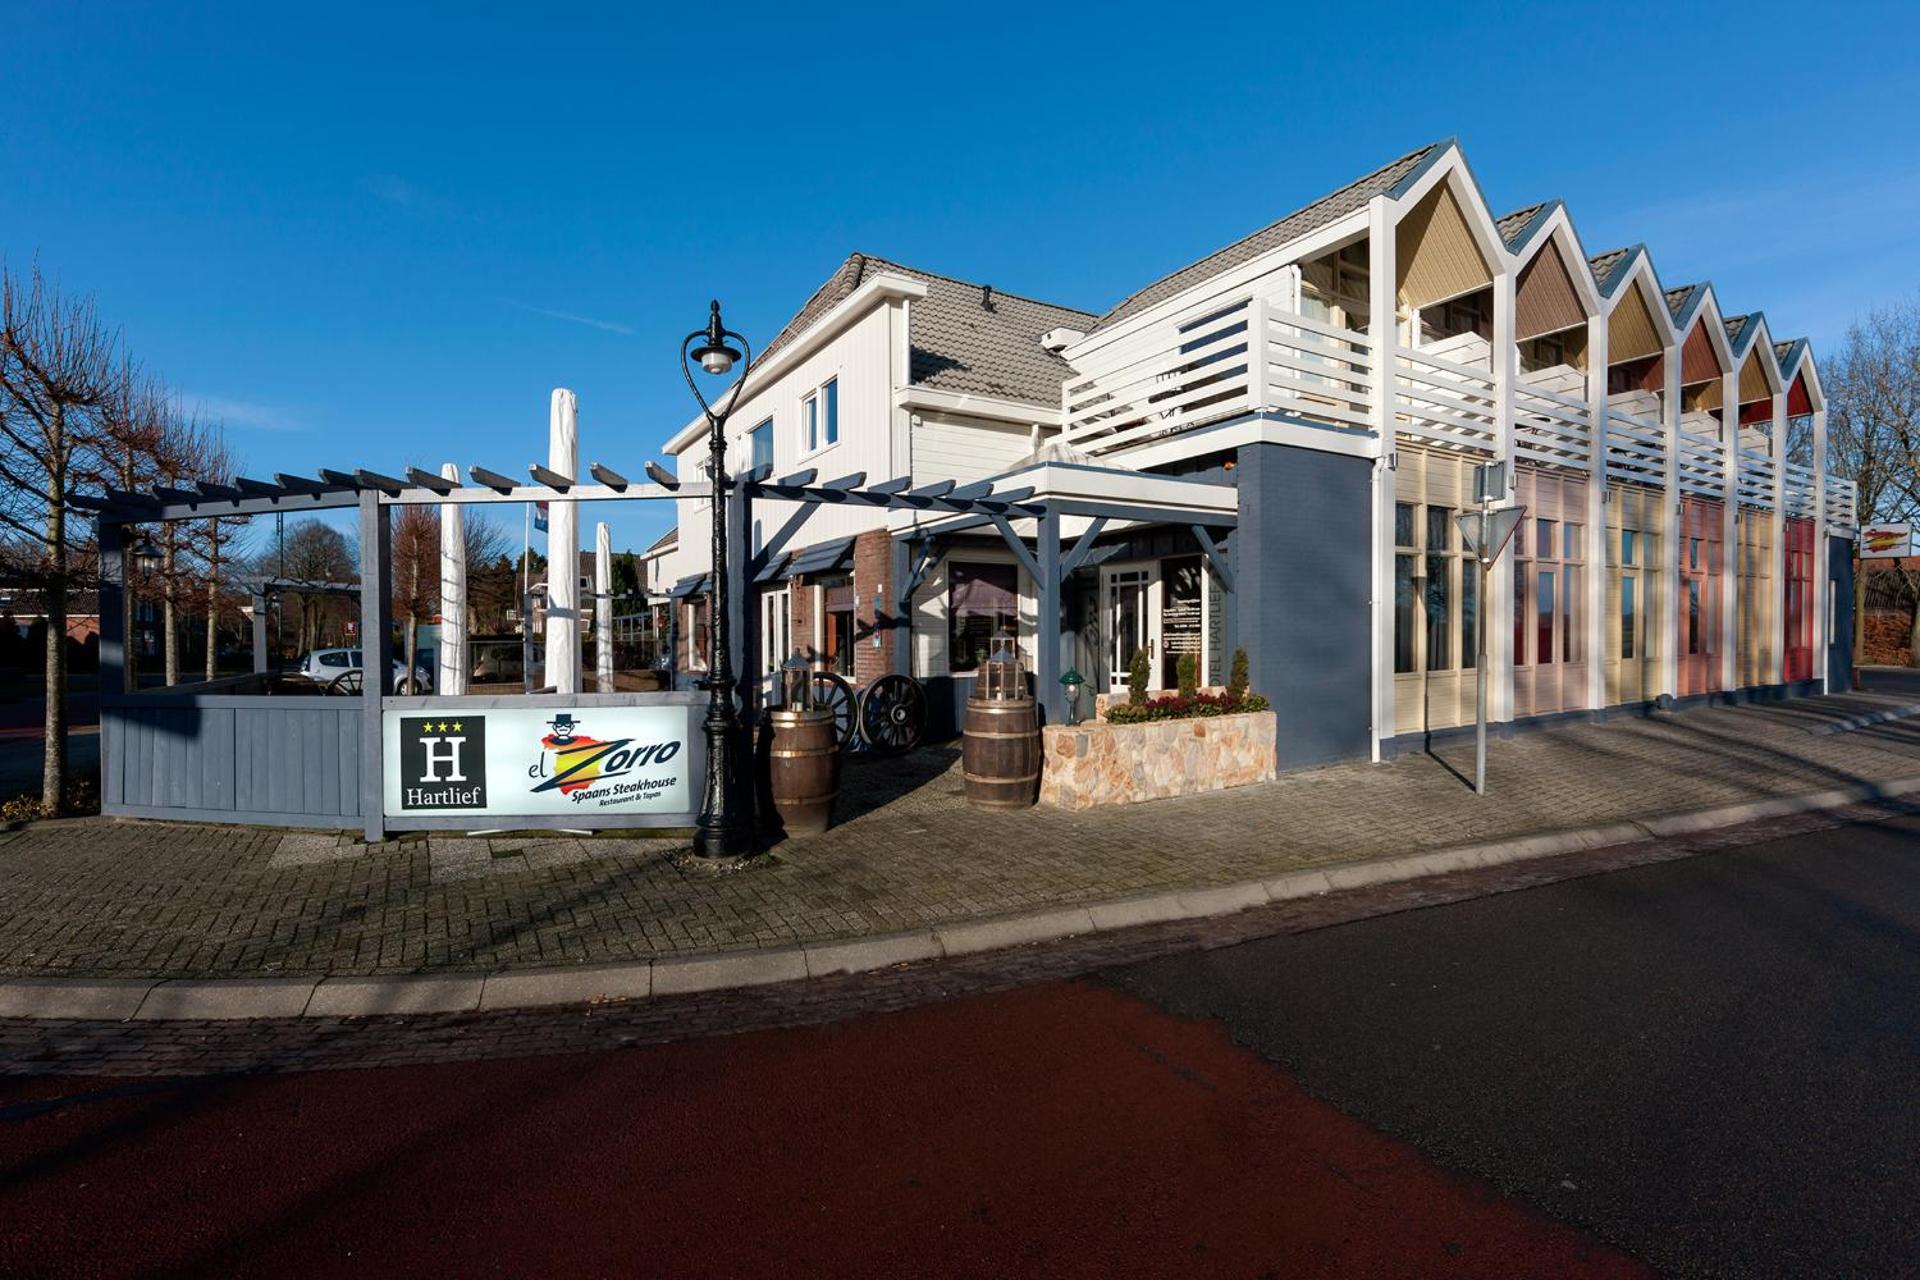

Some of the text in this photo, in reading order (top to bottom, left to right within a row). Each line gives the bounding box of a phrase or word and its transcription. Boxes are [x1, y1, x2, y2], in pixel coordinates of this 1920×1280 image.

[419, 736, 467, 782] H
[528, 738, 682, 793] el Zorro
[406, 786, 482, 806] Hartlief
[571, 776, 677, 804] Spaans Steakhouse
[599, 791, 661, 807] Restaurant & Tapas
